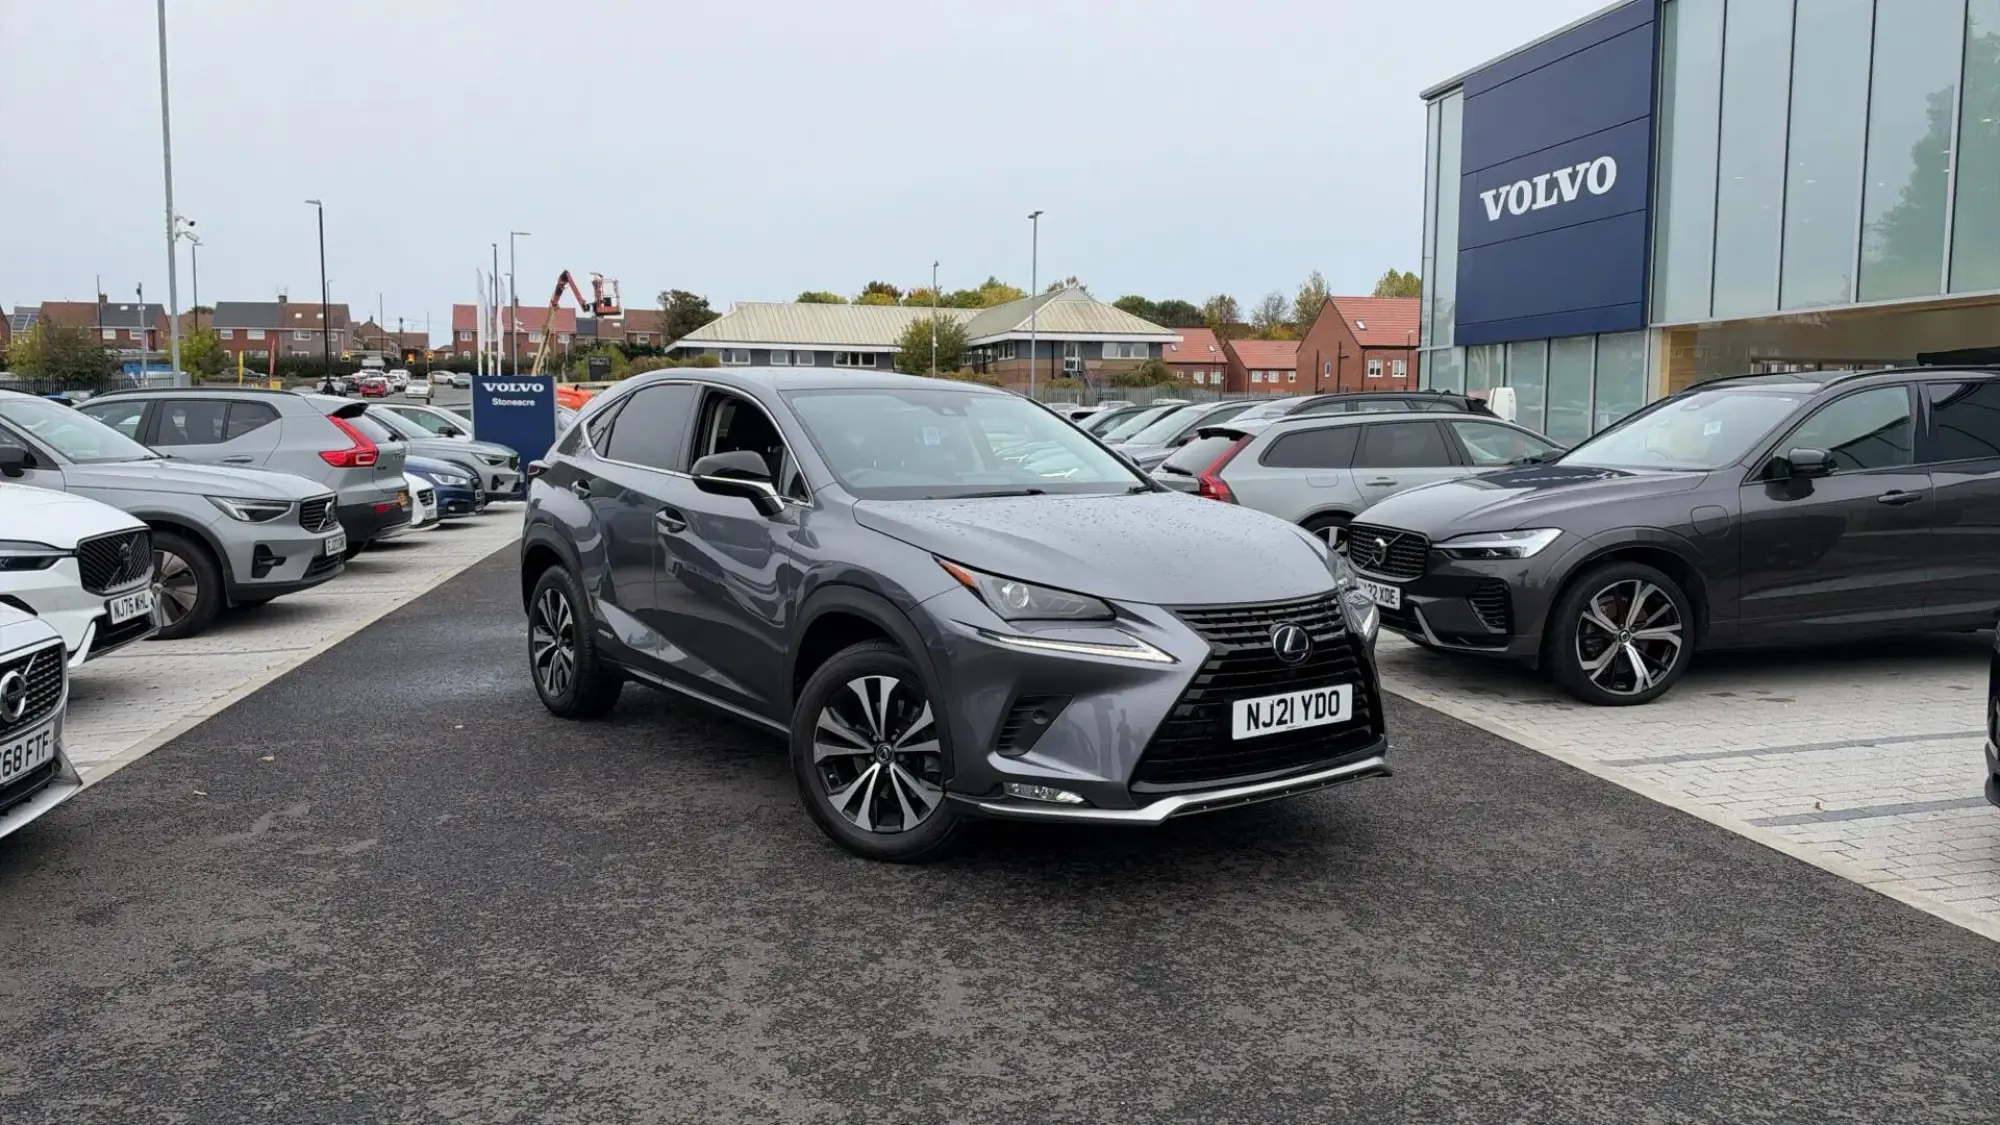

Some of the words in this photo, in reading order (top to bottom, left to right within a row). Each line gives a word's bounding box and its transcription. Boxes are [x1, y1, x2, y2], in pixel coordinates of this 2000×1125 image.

[1480, 156, 1617, 221] VOLVO
[482, 382, 544, 392] VOLVO
[491, 397, 535, 406] Stoneacre
[1246, 697, 1294, 731] NJ21
[1301, 690, 1340, 721] YDO
[0, 744, 22, 777] 68
[26, 729, 50, 767] FTF
